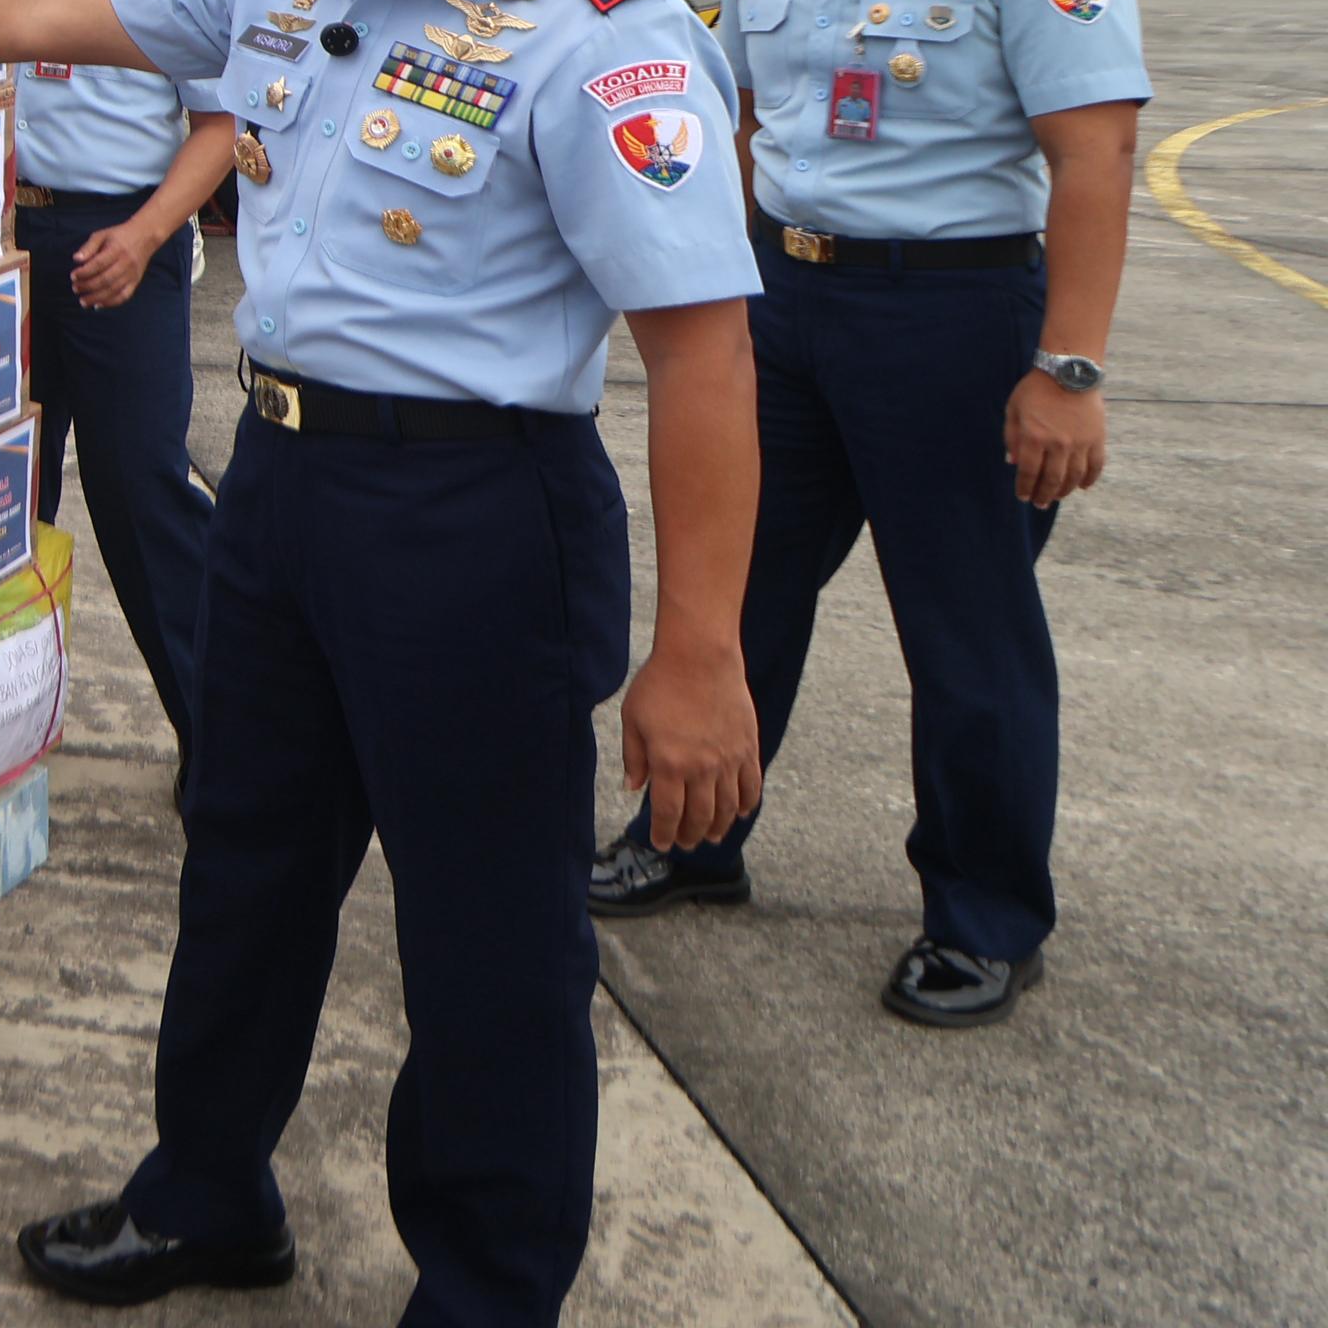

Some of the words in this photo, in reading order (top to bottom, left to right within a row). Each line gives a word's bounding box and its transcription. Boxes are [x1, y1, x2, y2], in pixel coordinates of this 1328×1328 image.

[592, 65, 664, 95] KODAU
[604, 86, 636, 106] LANUD
[638, 80, 683, 94] DHOMBER
